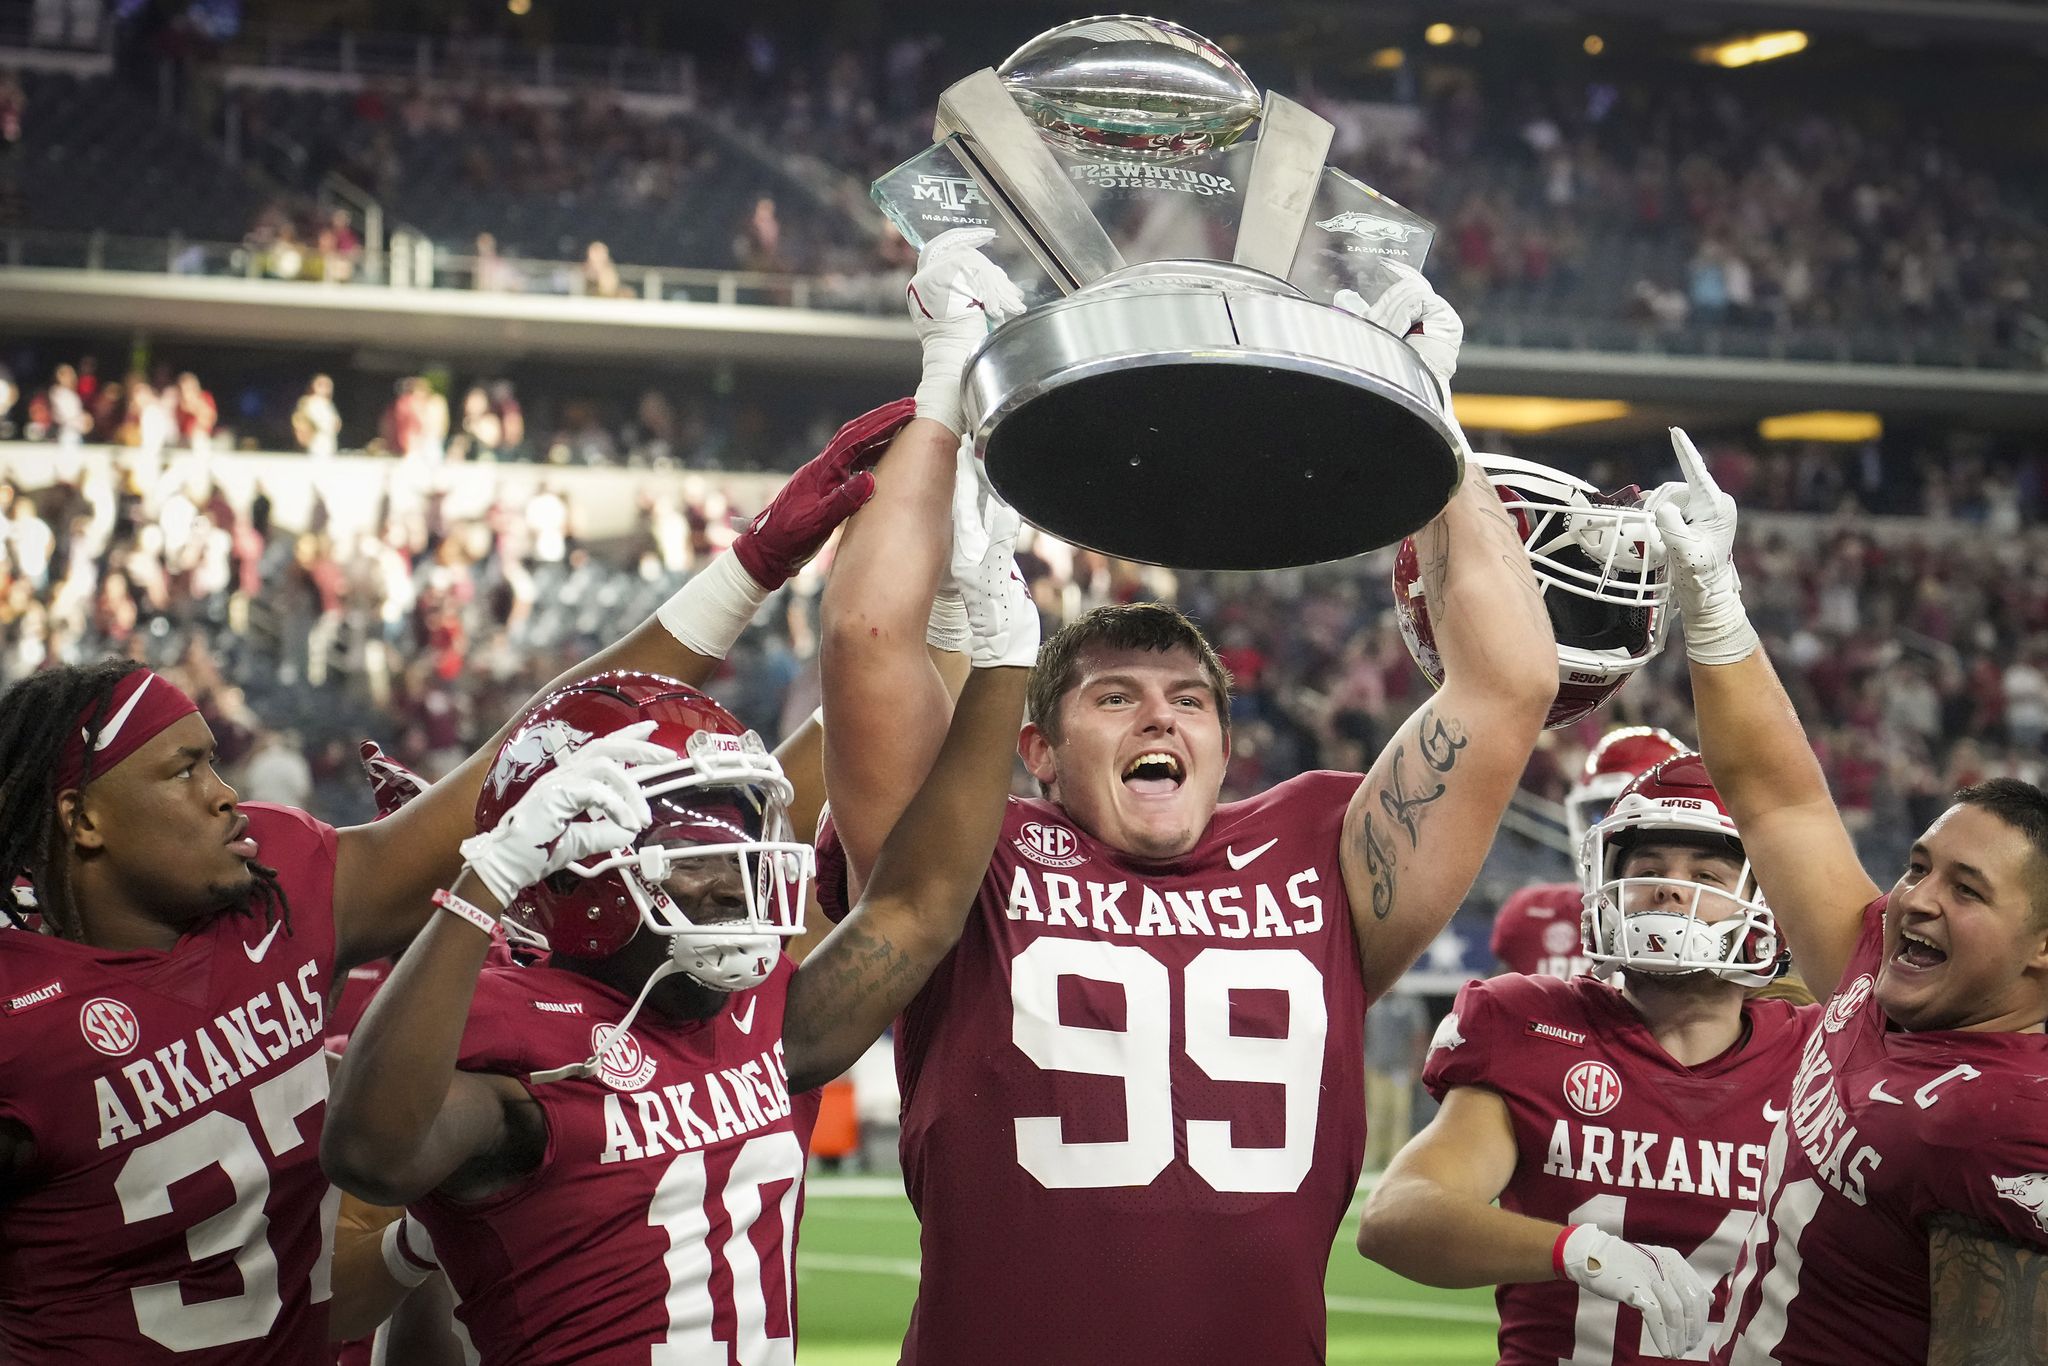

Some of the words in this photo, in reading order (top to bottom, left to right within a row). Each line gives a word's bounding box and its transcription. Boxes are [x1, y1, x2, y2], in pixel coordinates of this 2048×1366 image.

[1568, 671, 1608, 684] HOGS
[1661, 798, 1702, 810] HOGS
[1021, 848, 1077, 867] GRADUATE
[1026, 824, 1072, 856] SEC
[1005, 866, 1324, 938] ARKANSAS
[11, 982, 63, 1010] EQUALITY
[534, 1001, 584, 1014] EQUALITY
[86, 1002, 135, 1051] SEC
[1534, 1023, 1586, 1044] EQUALITY
[94, 958, 324, 1150] ARKANSAS
[1011, 936, 1328, 1193] 99
[607, 1066, 652, 1089] GRADUATE
[1569, 1065, 1617, 1111] SEC
[1913, 1063, 1982, 1110] C
[600, 1037, 791, 1165] ARKANSAS
[647, 1131, 804, 1366] 10
